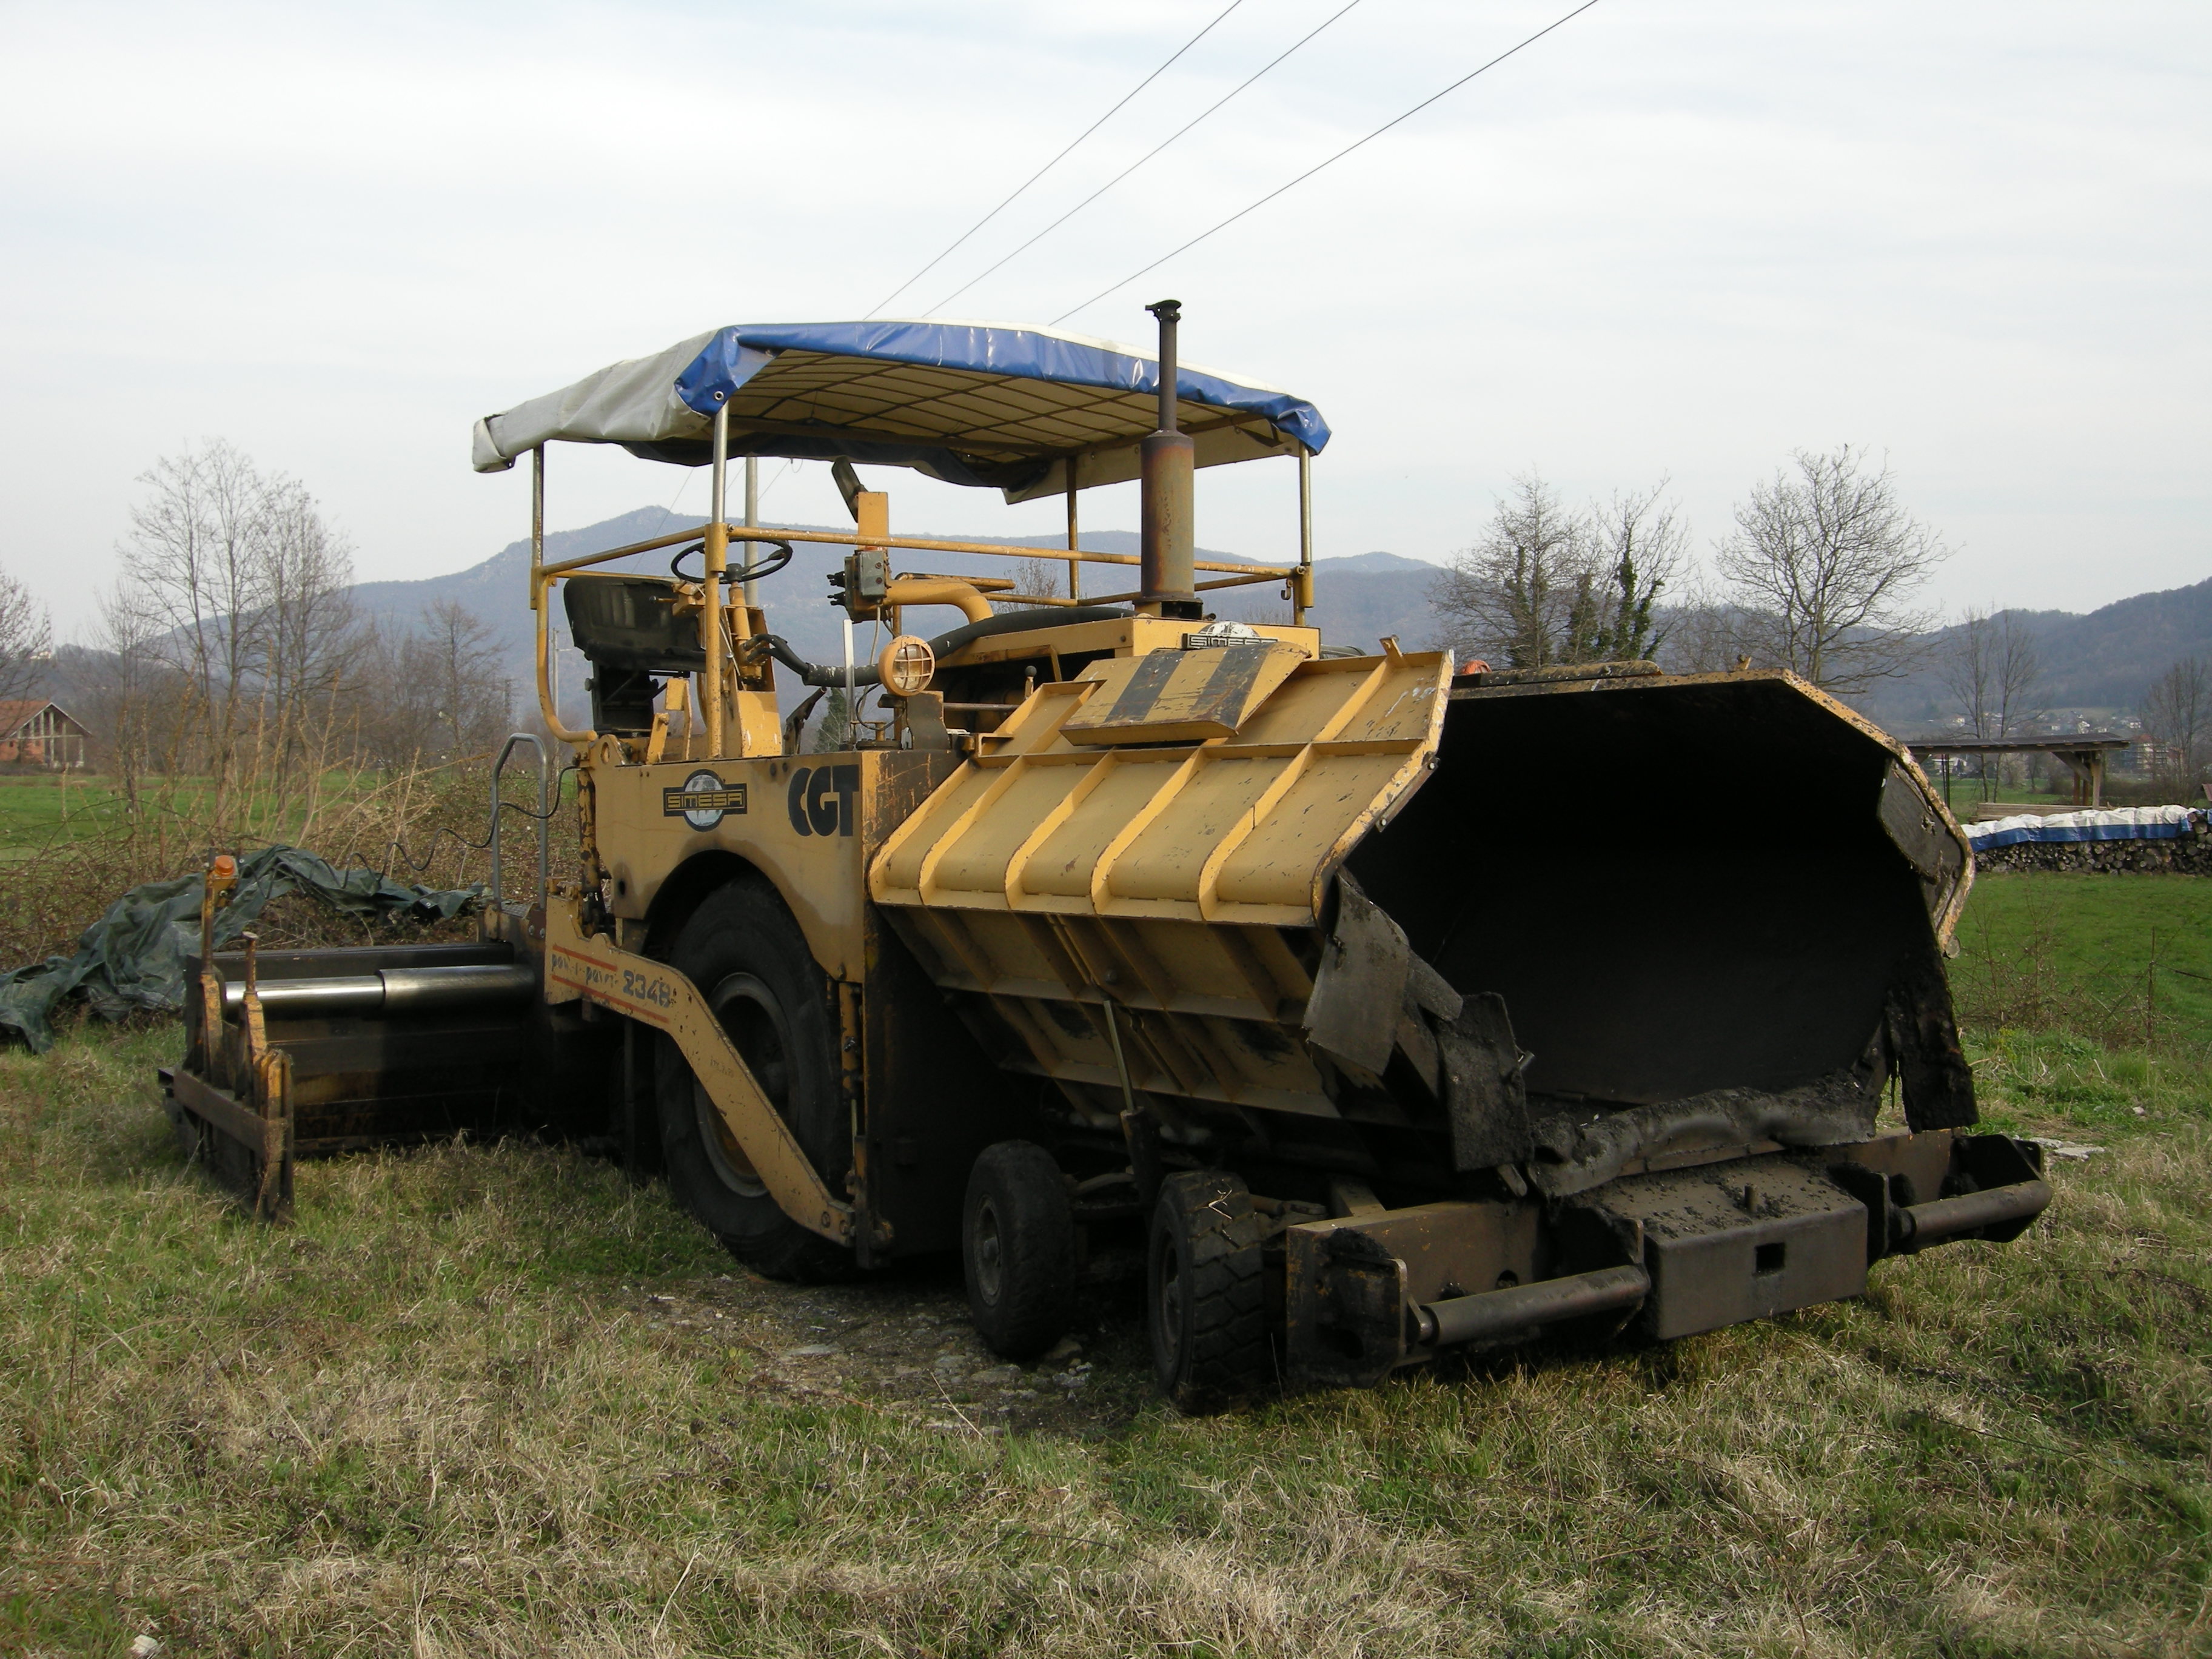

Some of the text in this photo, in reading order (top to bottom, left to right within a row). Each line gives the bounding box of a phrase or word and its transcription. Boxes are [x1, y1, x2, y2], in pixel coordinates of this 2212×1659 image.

[1190, 636, 1278, 647] SIMES
[668, 792, 742, 808] SIMESA
[788, 764, 859, 837] CGT
[623, 970, 671, 1008] 2348
